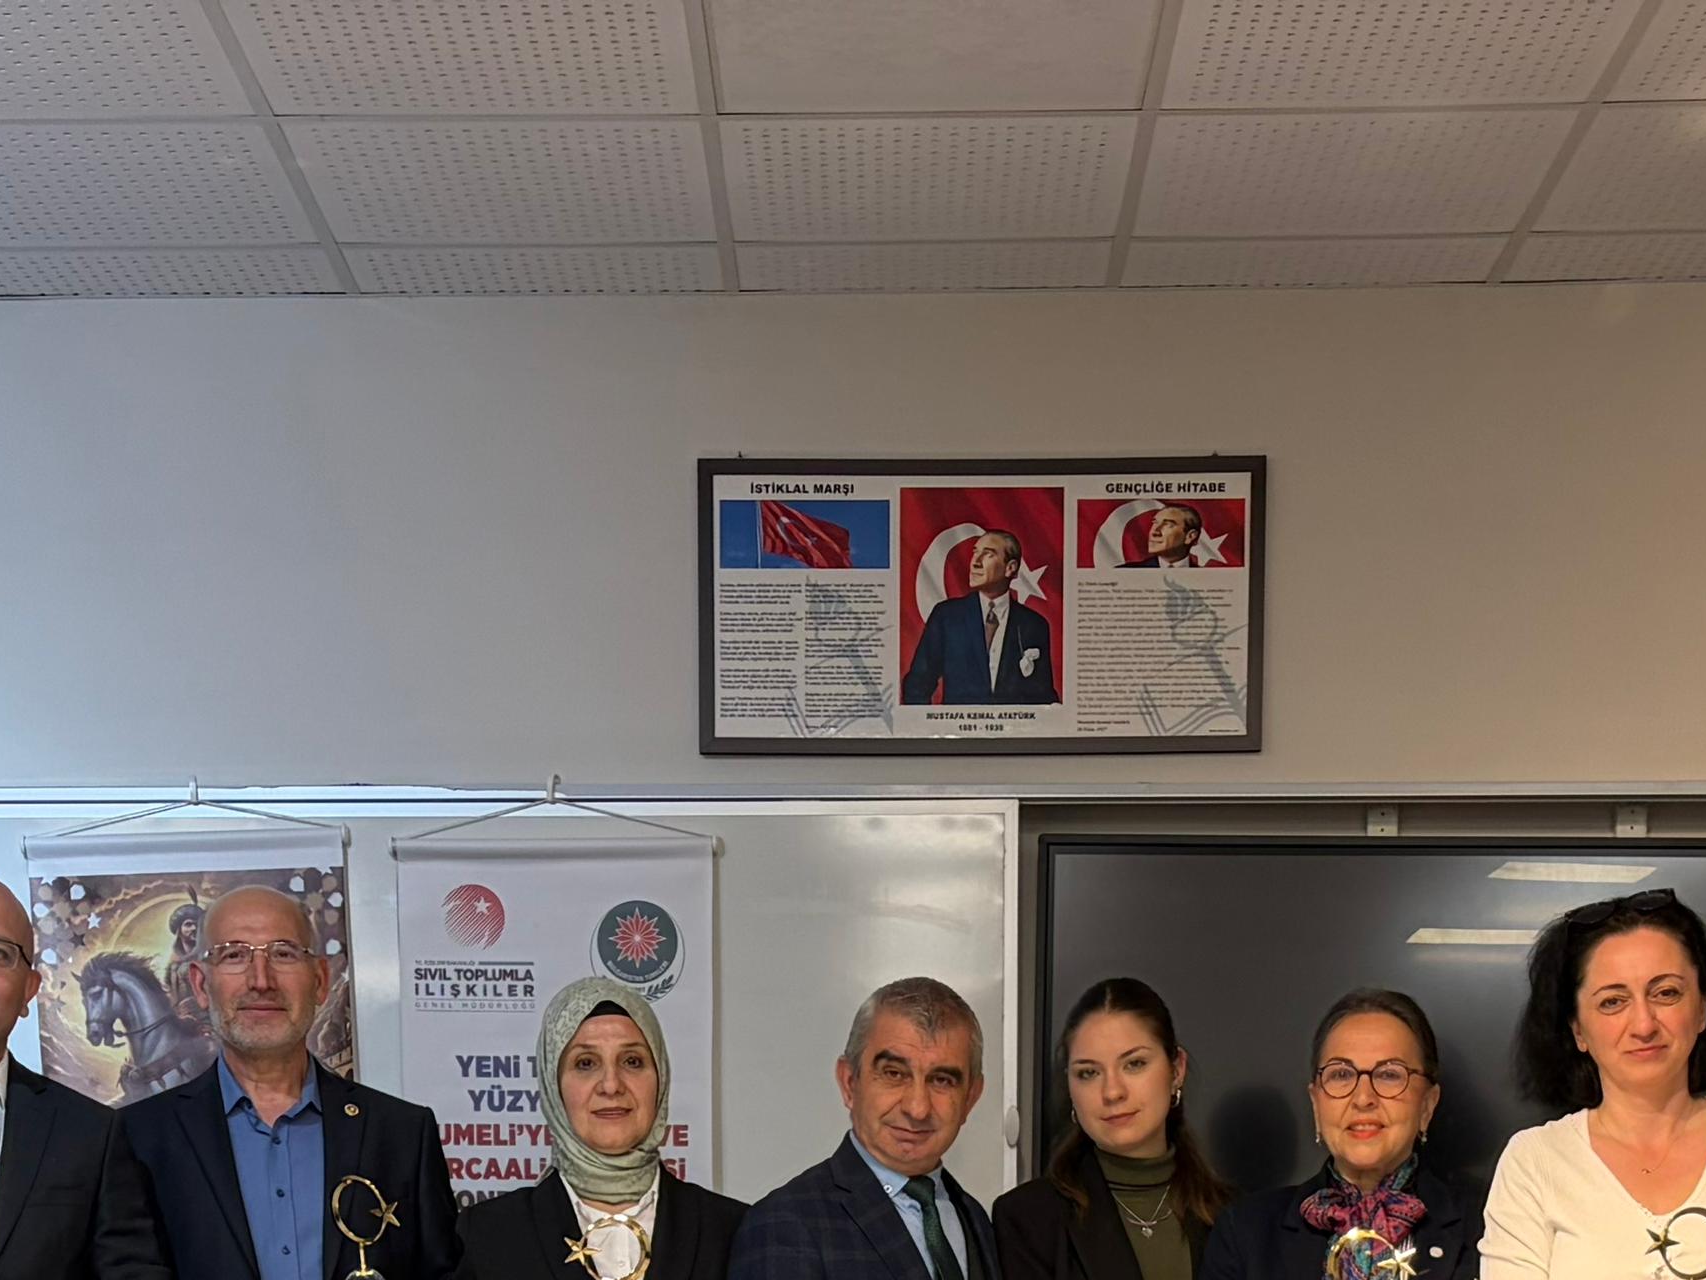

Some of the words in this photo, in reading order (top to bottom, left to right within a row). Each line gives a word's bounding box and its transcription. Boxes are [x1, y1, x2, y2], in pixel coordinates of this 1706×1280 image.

[750, 482, 809, 494] İSTİKLAL
[813, 483, 854, 496] MARŞI
[1105, 480, 1174, 496] GENÇLİĞE
[454, 968, 534, 981] TOPLUMLA
[468, 1084, 541, 1112] YÜZY
